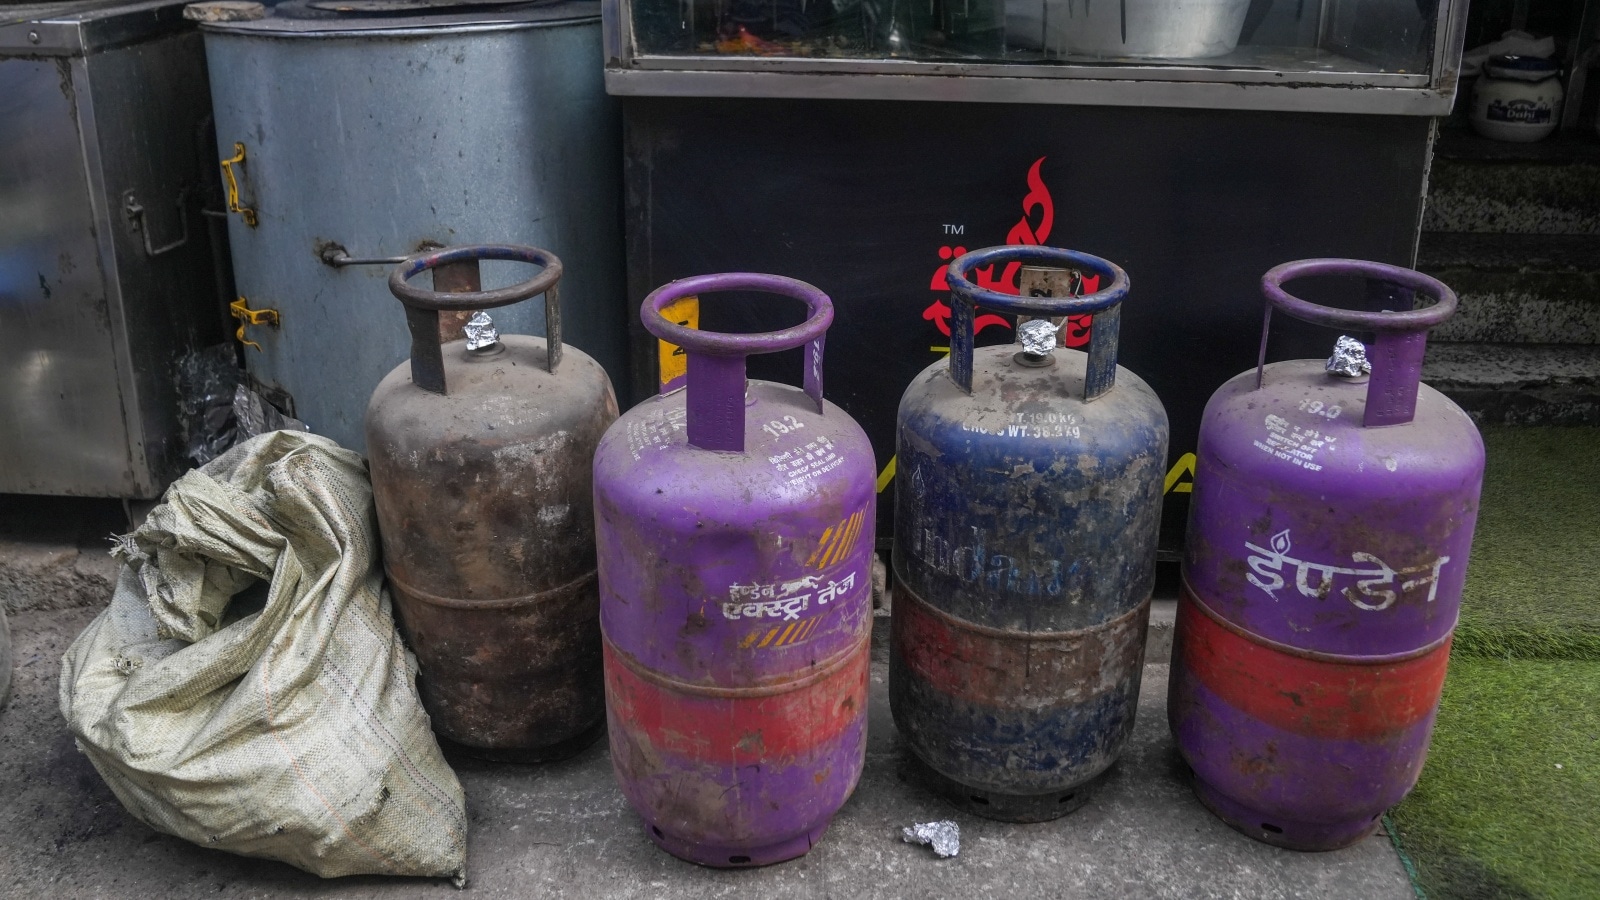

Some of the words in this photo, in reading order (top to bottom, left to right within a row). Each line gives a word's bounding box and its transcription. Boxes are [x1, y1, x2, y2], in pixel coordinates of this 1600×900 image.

[1506, 109, 1536, 119] Dahi
[942, 224, 964, 235] TM
[1298, 398, 1342, 419] 19.0
[762, 415, 804, 437] 19.2
[1008, 425, 1030, 438] WT.
[1253, 439, 1274, 455] WHEN
[1274, 450, 1292, 461] NOT
[1292, 457, 1303, 466] IN
[1303, 462, 1323, 472] USE
[1300, 444, 1318, 454] OFF
[788, 464, 809, 478] CHECK
[810, 459, 826, 469] SEAL
[812, 469, 822, 477] ON
[817, 571, 856, 605] तेज
